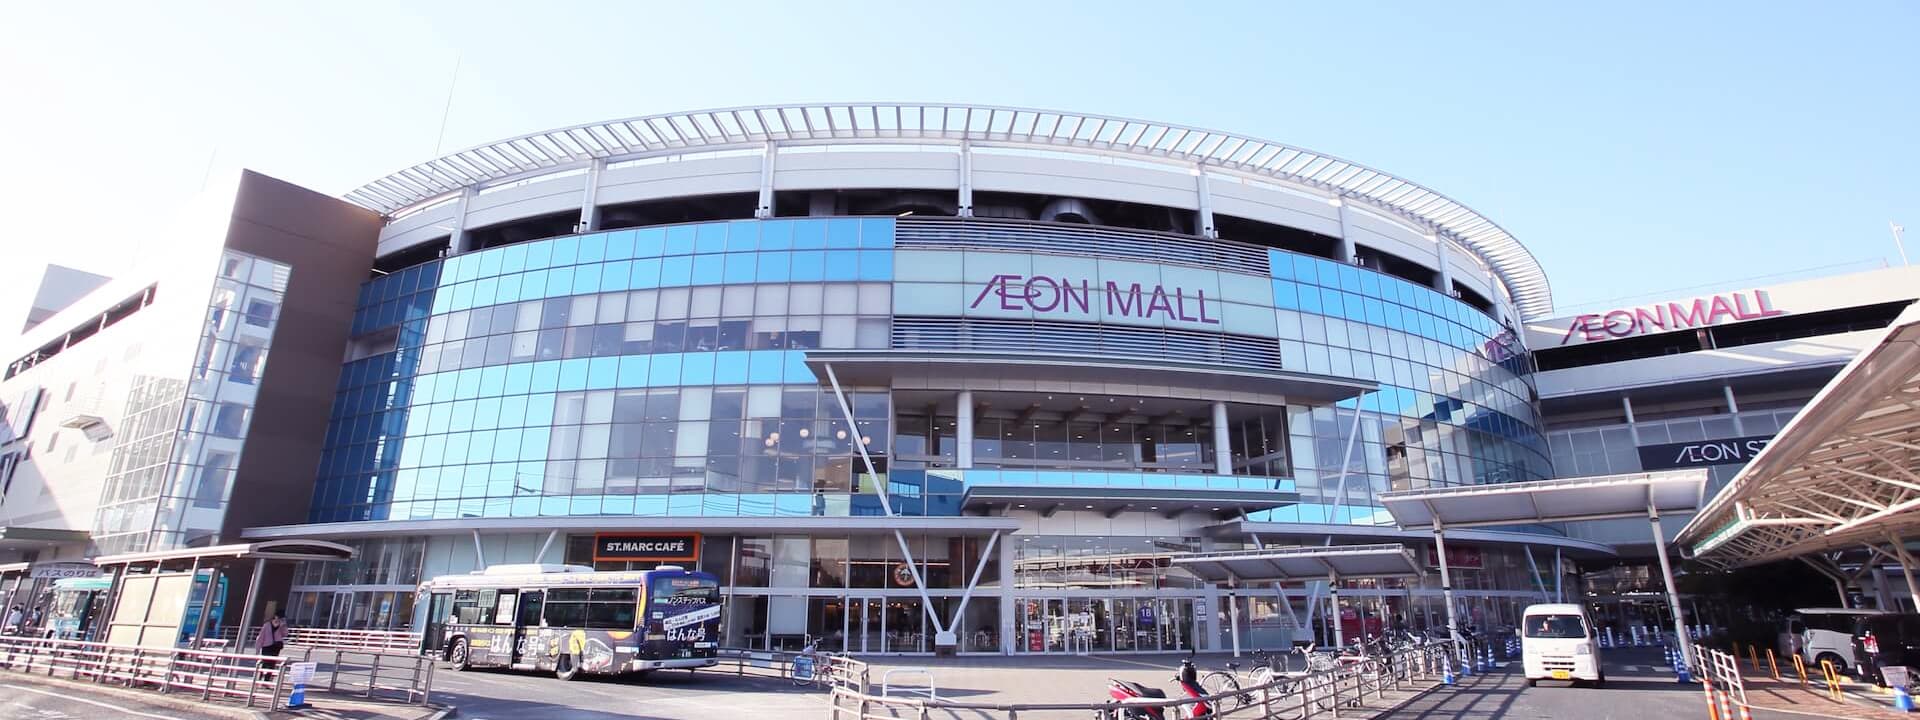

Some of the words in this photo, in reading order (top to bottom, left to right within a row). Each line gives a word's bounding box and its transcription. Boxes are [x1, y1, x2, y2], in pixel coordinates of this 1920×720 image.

[1106, 281, 1220, 324] MALL
[1669, 290, 1788, 329] MALL
[606, 542, 653, 551] ST.MARC
[655, 540, 685, 551] CAFÉ
[38, 569, 97, 578] バスのりば
[668, 596, 706, 606] ノンステップバス
[667, 628, 706, 641] はんな号
[490, 634, 538, 656] はんな号
